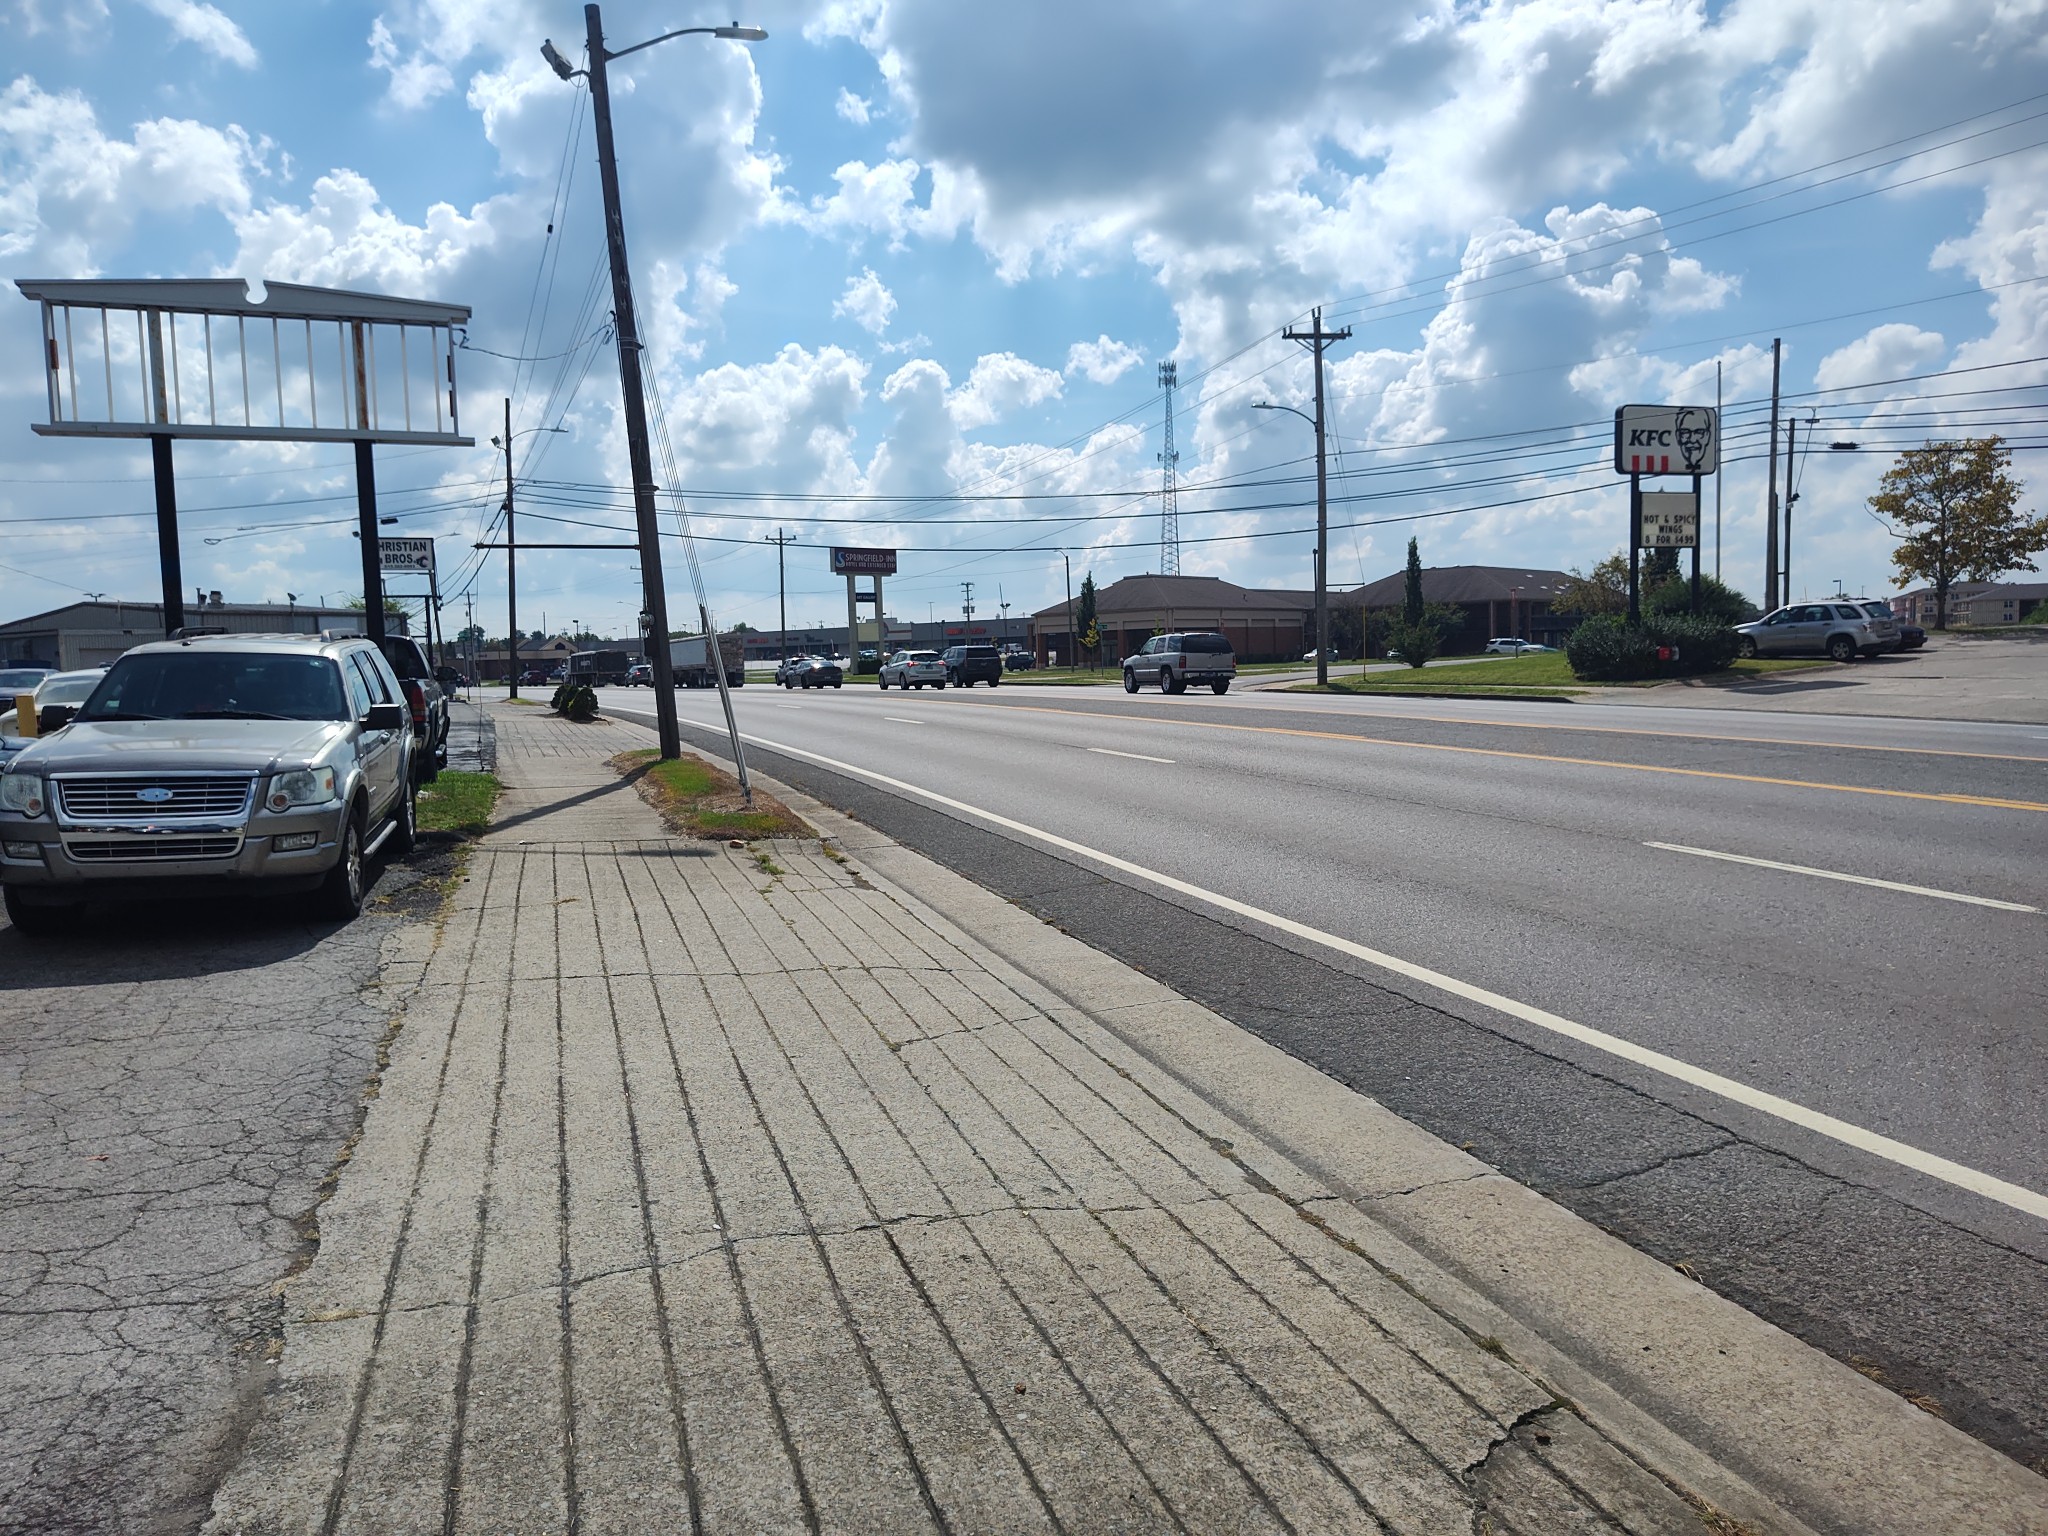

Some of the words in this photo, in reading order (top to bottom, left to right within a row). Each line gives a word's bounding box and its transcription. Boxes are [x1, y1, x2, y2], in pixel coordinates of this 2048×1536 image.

[1629, 429, 1671, 447] KFC
[1643, 514, 1659, 524] HOT
[1664, 514, 1669, 524] &
[1674, 514, 1695, 524] SPICY
[1659, 525, 1683, 534] WINGS
[1656, 535, 1670, 544] FOR
[379, 542, 427, 552] HRISTIAN
[846, 553, 884, 562] SPRINGFIELD
